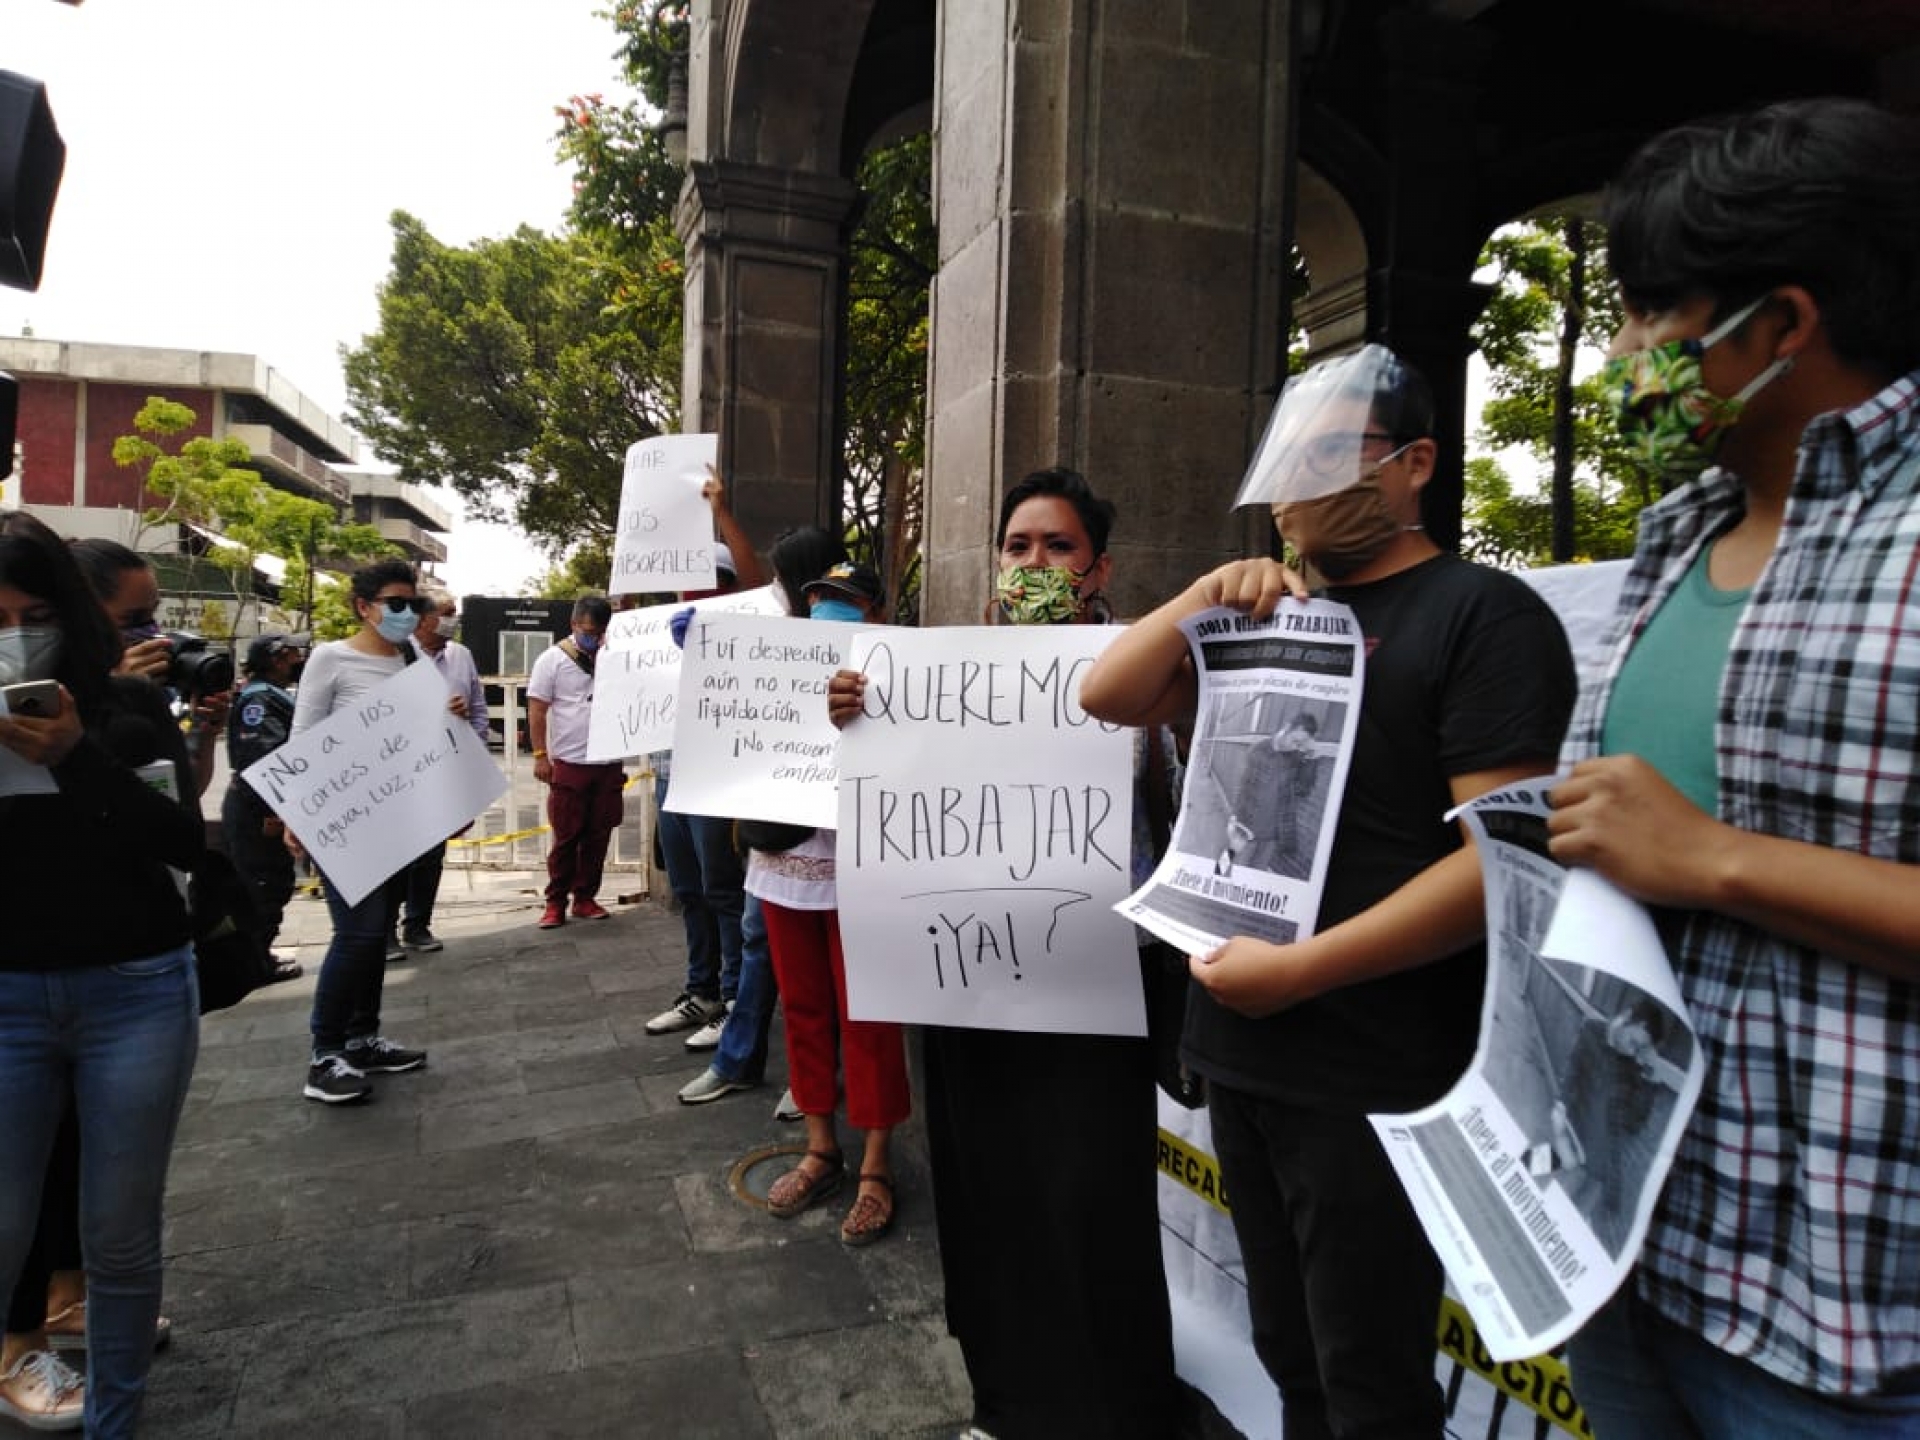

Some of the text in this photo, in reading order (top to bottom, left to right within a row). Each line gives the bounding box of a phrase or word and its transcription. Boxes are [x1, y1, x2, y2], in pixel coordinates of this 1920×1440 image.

[703, 671, 740, 692] aún
[755, 676, 778, 692] no
[749, 636, 841, 666] despedido
[261, 752, 309, 805] ¡No
[322, 734, 342, 755] a
[300, 733, 410, 816] cortes de
[733, 728, 841, 758] ¡No encuen
[317, 804, 371, 848] agua,
[843, 774, 1124, 882] TRABAJAR
[926, 910, 1023, 989] ¡YA!
[1491, 1153, 1516, 1174] al
[1502, 1170, 1589, 1290] movimiento!
[1442, 1316, 1591, 1435] AUCIÓ
